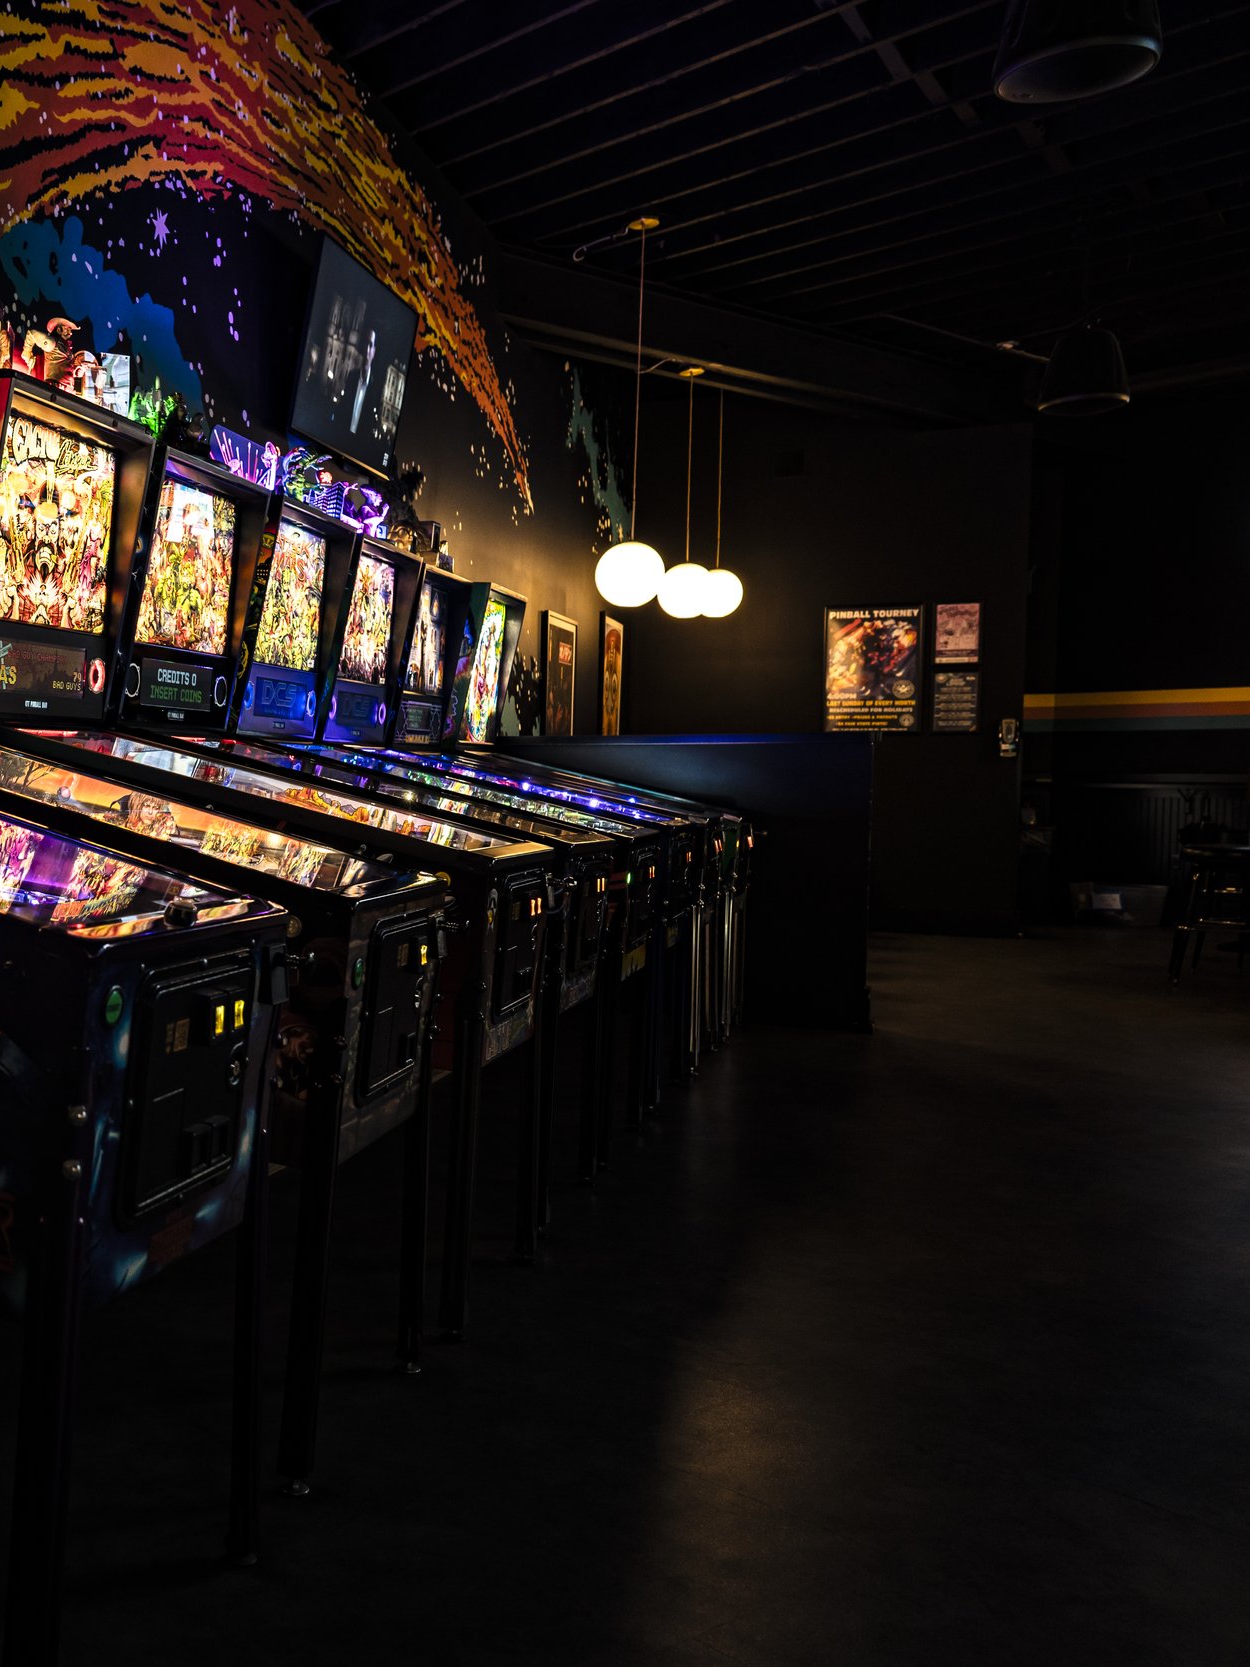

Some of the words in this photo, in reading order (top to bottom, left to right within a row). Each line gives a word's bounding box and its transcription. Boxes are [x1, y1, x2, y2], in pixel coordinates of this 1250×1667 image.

[829, 610, 870, 620] PINBALL
[873, 608, 919, 618] TOURNEY
[73, 671, 82, 683] 79
[158, 668, 190, 686] CREDITS
[192, 673, 197, 687] 0
[53, 680, 64, 690] BAD
[65, 682, 82, 691] GUYS
[150, 685, 179, 701] INSERT
[180, 689, 202, 703] COINS
[261, 679, 298, 708] DCS
